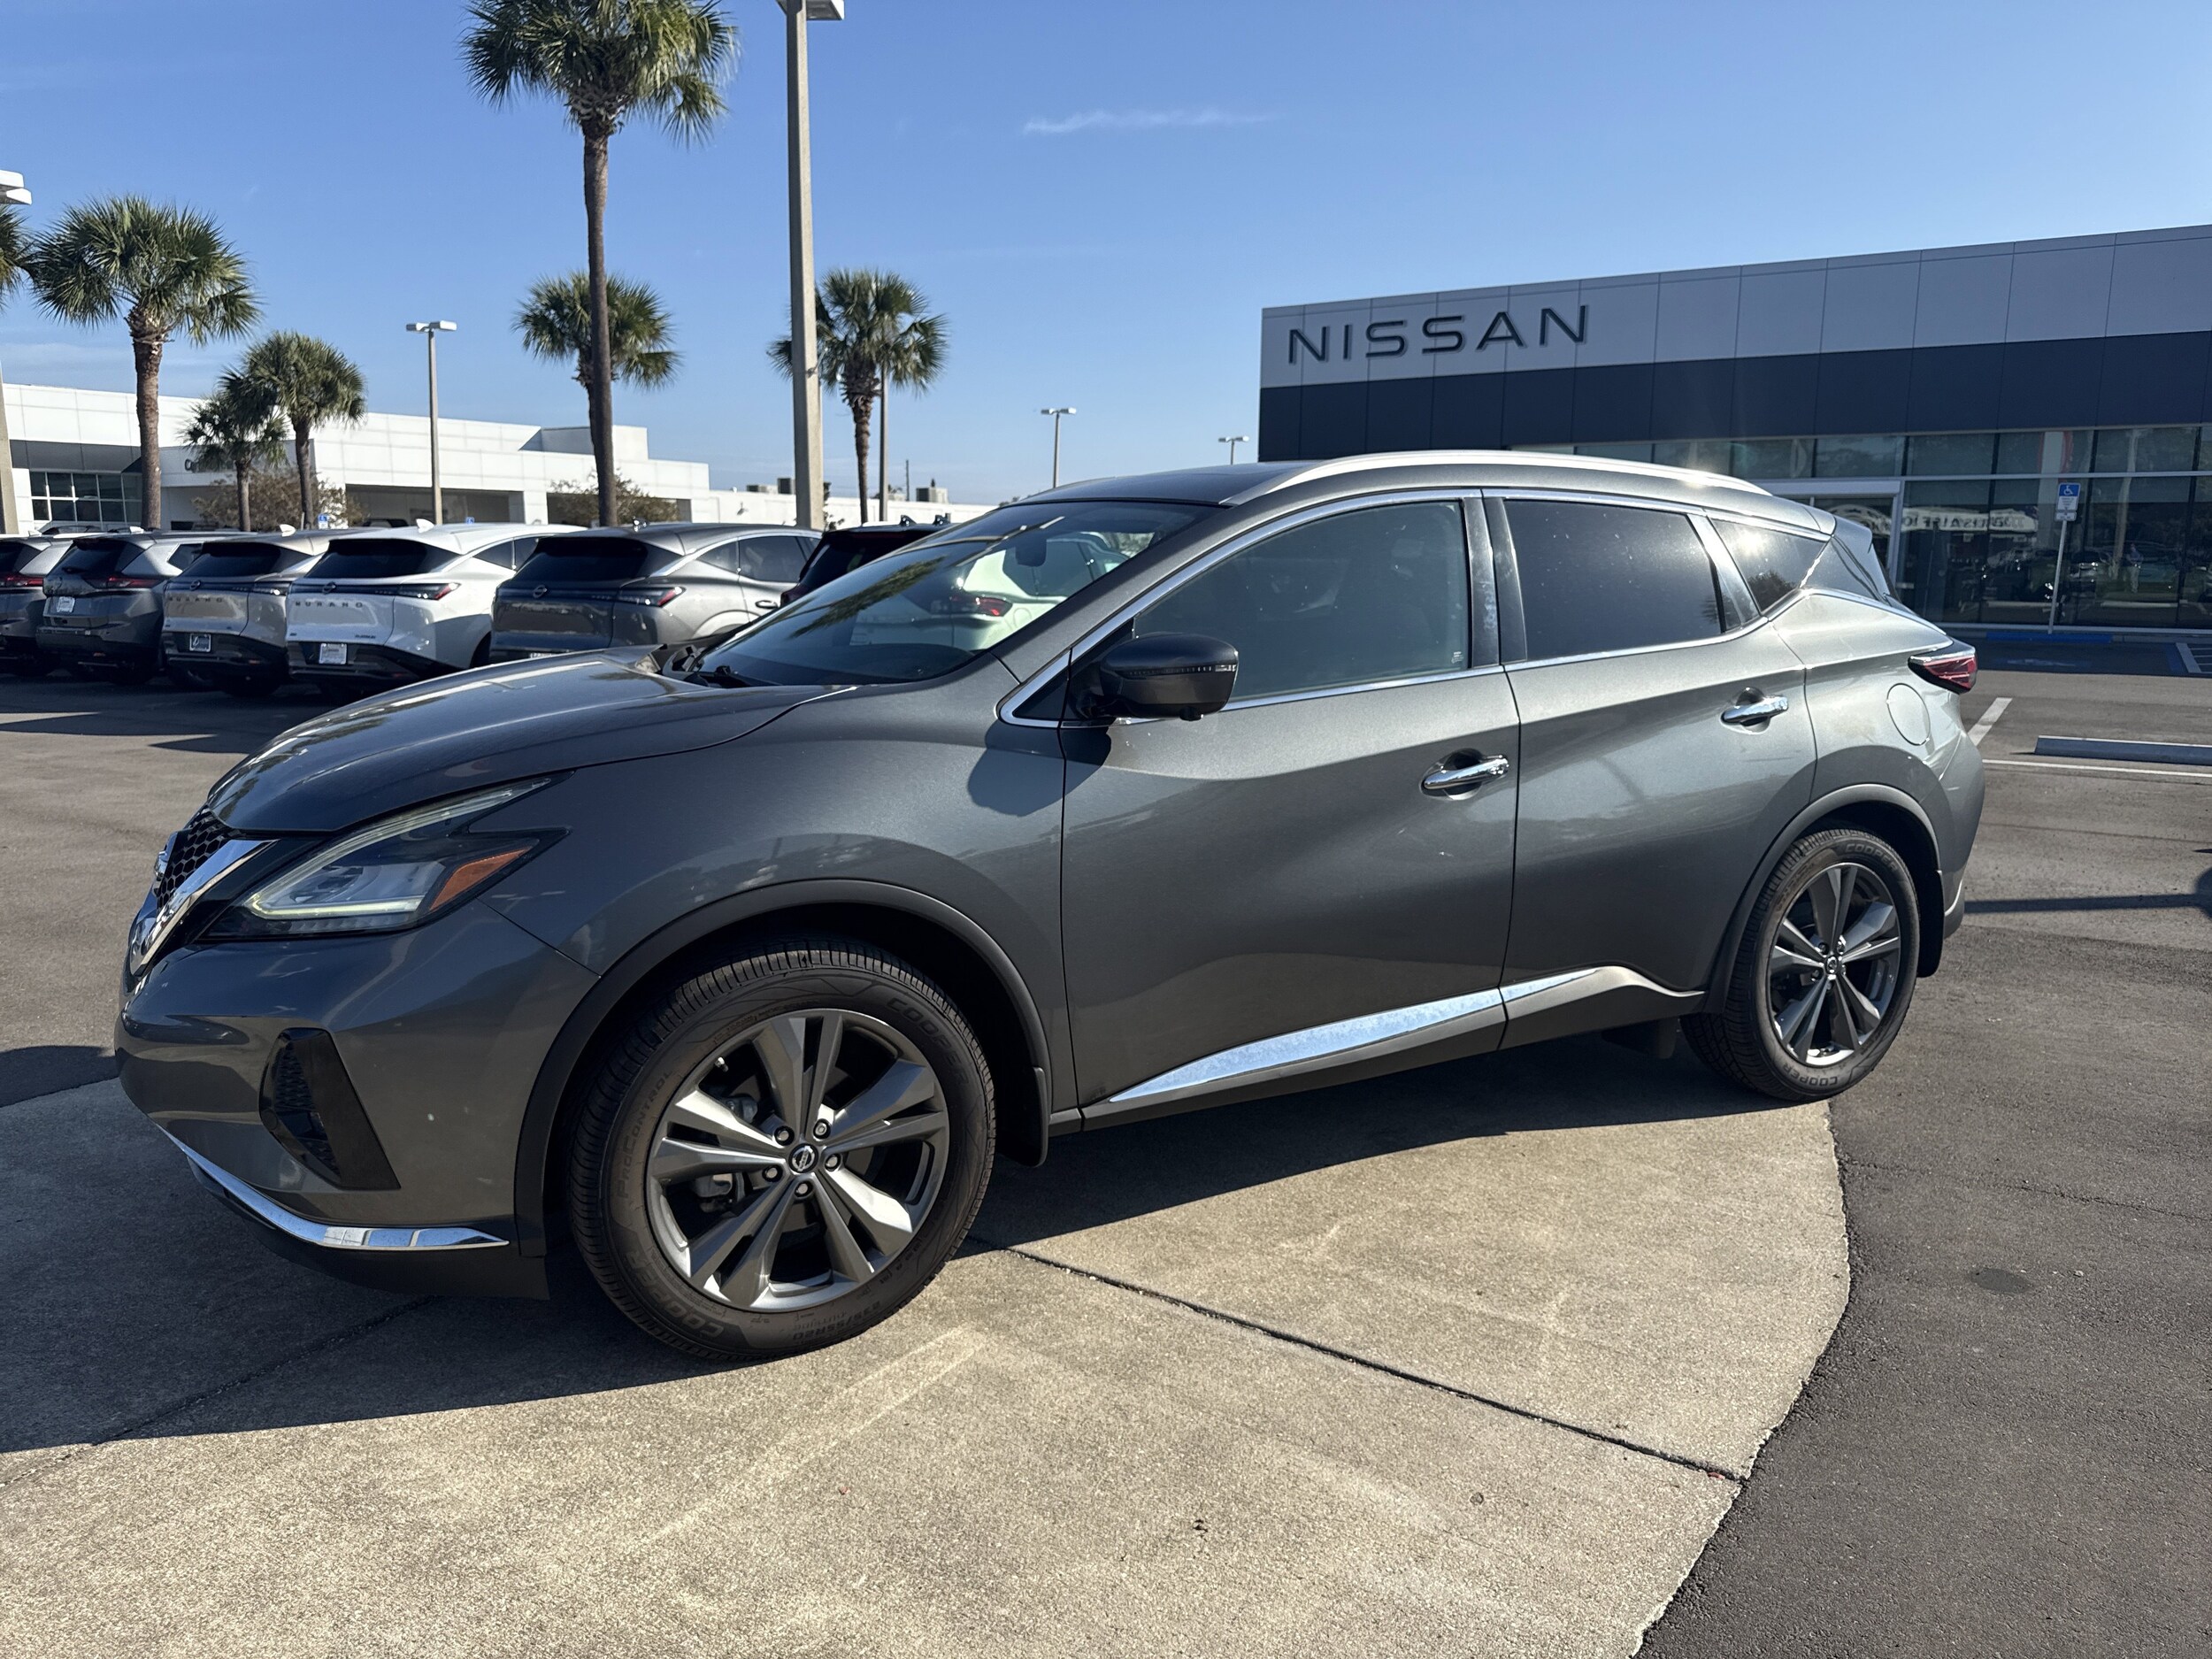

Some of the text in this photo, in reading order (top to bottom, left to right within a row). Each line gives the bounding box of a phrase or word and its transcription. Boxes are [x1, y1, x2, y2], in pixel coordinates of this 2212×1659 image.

[1288, 304, 1589, 365] NISSAN
[1845, 842, 1899, 872] COOPER
[887, 996, 970, 1087] COOPER
[1783, 1063, 1838, 1087] COOPER
[625, 1250, 725, 1338] COOPER
